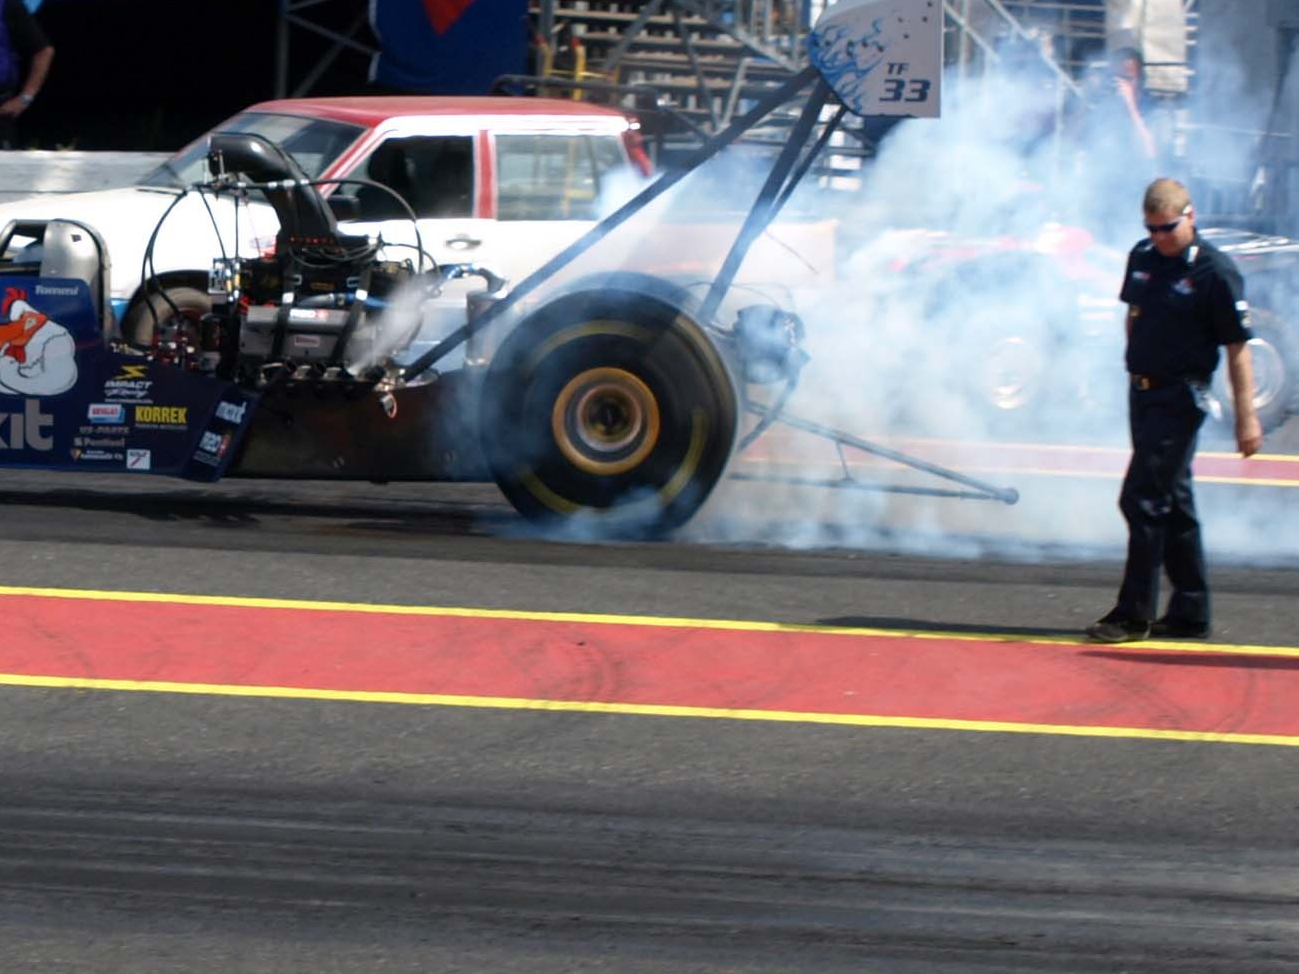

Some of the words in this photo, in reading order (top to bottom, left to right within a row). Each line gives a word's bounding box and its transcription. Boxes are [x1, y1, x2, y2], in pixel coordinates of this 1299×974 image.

[886, 62, 910, 75] TF
[878, 79, 931, 103] 33
[134, 405, 188, 424] KORREK
